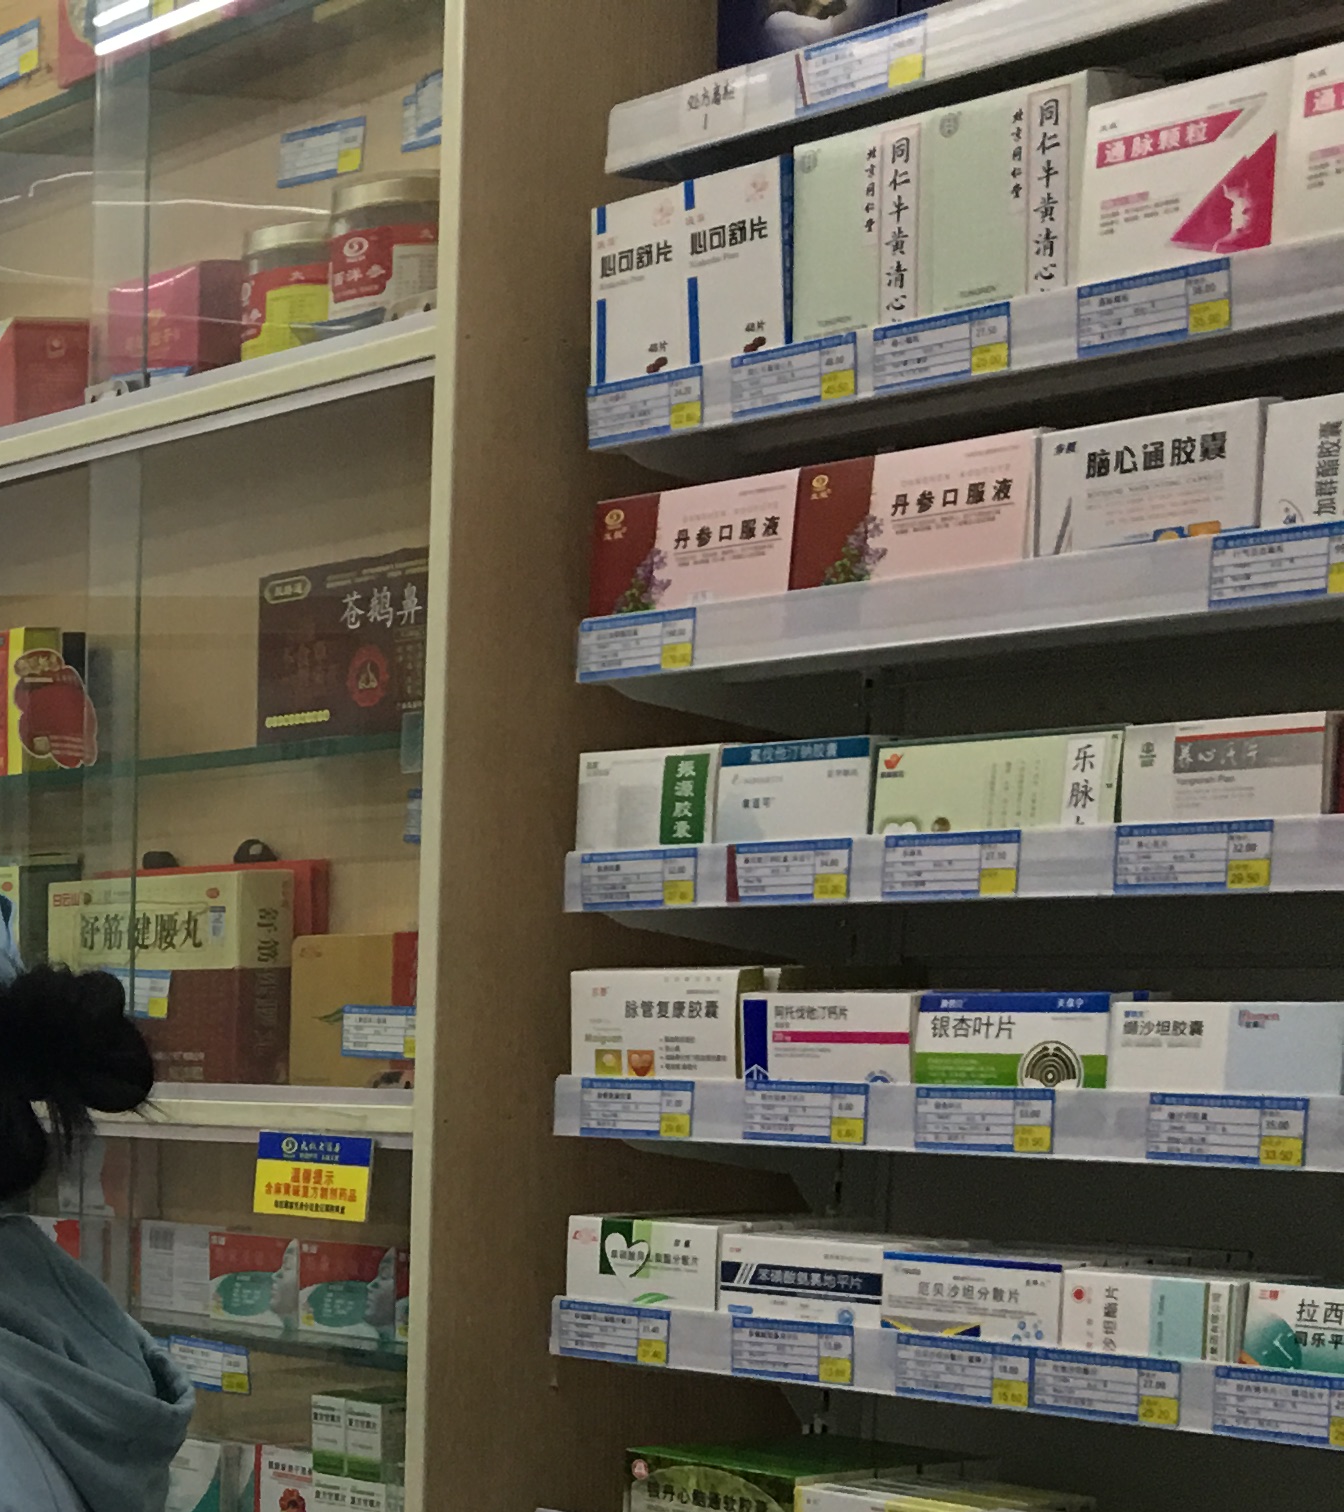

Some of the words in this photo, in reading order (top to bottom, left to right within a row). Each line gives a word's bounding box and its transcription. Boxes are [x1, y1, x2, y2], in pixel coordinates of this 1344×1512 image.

[1011, 108, 1025, 199] 北京同仁堂
[1103, 121, 1210, 164] 通脉颗粒
[864, 147, 877, 233] 北京同仁堂
[1033, 98, 1061, 292] 同仁牛黄清心
[690, 215, 769, 256] 心可舒片
[885, 136, 912, 323] 同仁牛黄清心
[600, 240, 673, 279] 心可舒片
[1085, 430, 1228, 480] 脑心通胶囊
[891, 477, 1013, 516] 丹参口服液
[674, 515, 781, 550] 丹参口服液
[339, 582, 423, 631] 苍鹅鼻
[672, 760, 697, 839] 振源胶囊
[1069, 744, 1096, 826] 乐脉
[79, 910, 203, 953] 舒筋健腰丸
[624, 999, 719, 1020] 脉管复康胶囊
[930, 1015, 1016, 1040] 银杏叶片
[1123, 1019, 1204, 1037] 缬沙坦胶囊
[1295, 1296, 1344, 1323] 拉西
